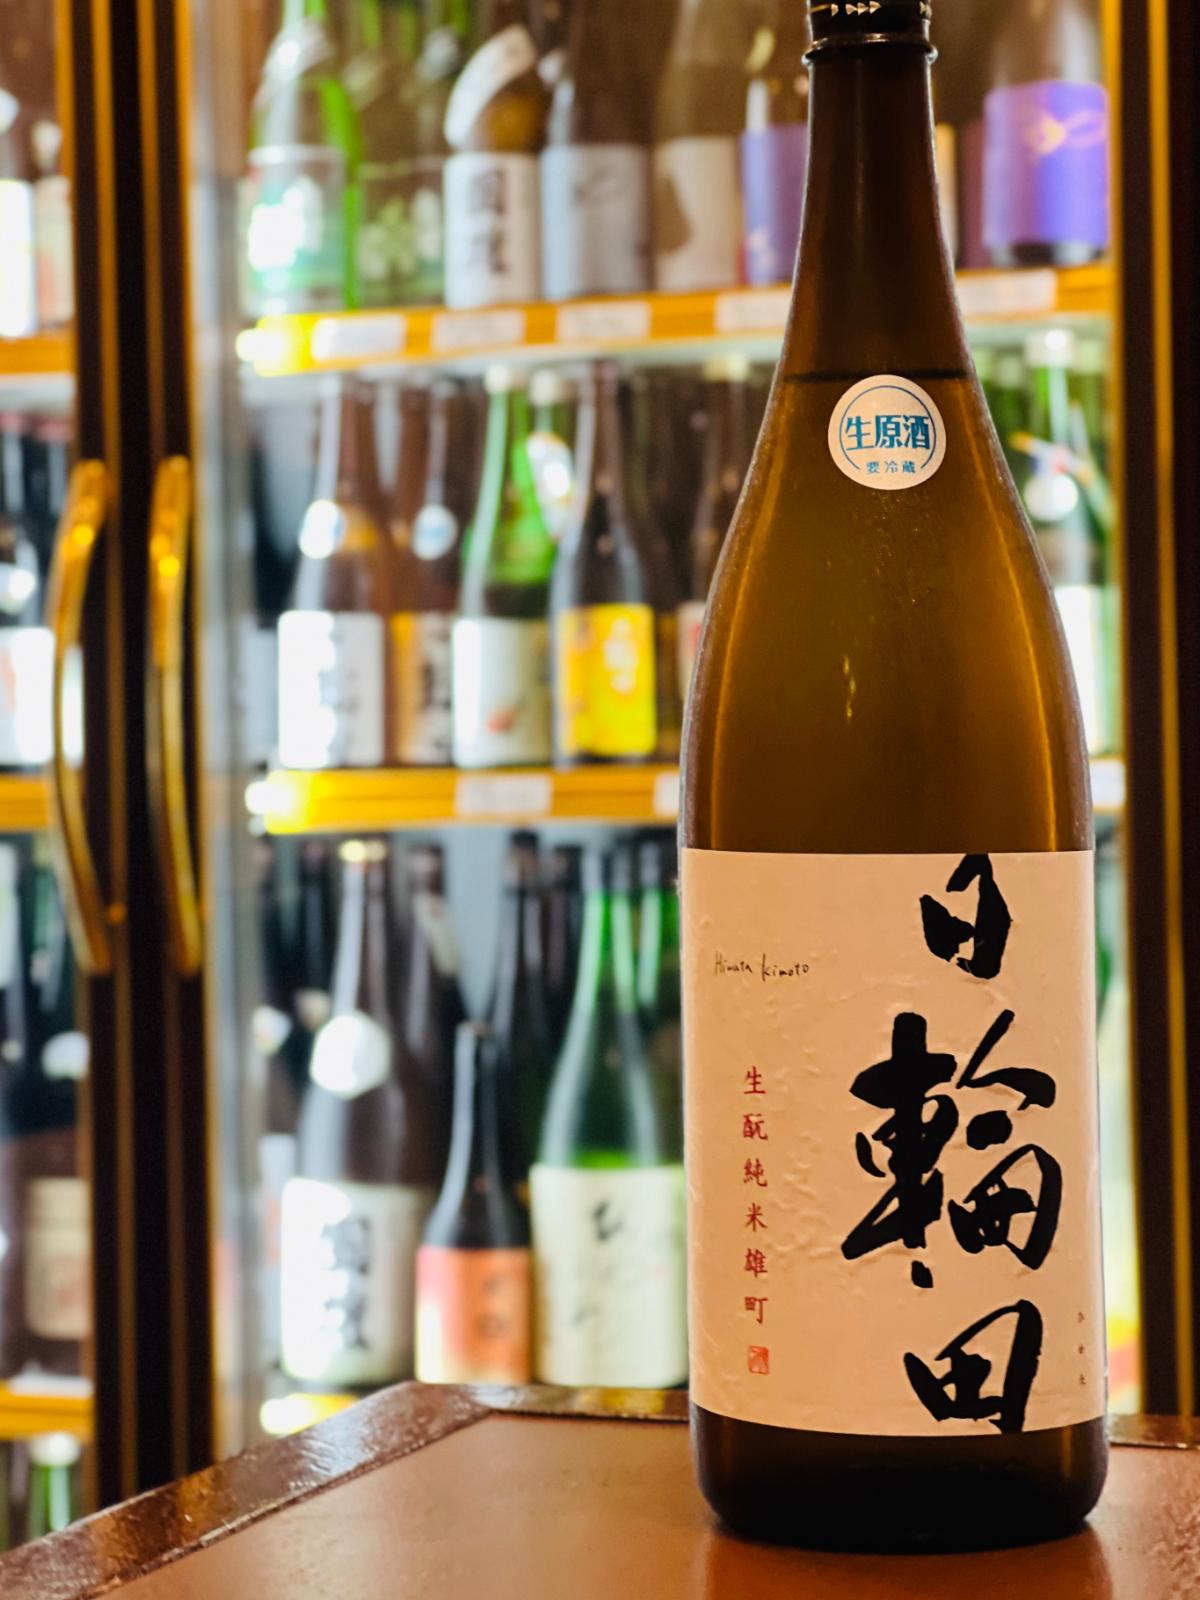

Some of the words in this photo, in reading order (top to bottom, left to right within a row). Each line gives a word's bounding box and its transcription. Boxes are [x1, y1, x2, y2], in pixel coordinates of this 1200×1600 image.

[845, 414, 930, 451] 生原酒
[866, 460, 916, 474] 要冷蔵
[742, 1065, 769, 1325] 生酛純米雄町
[841, 853, 1062, 1433] 日輪田
